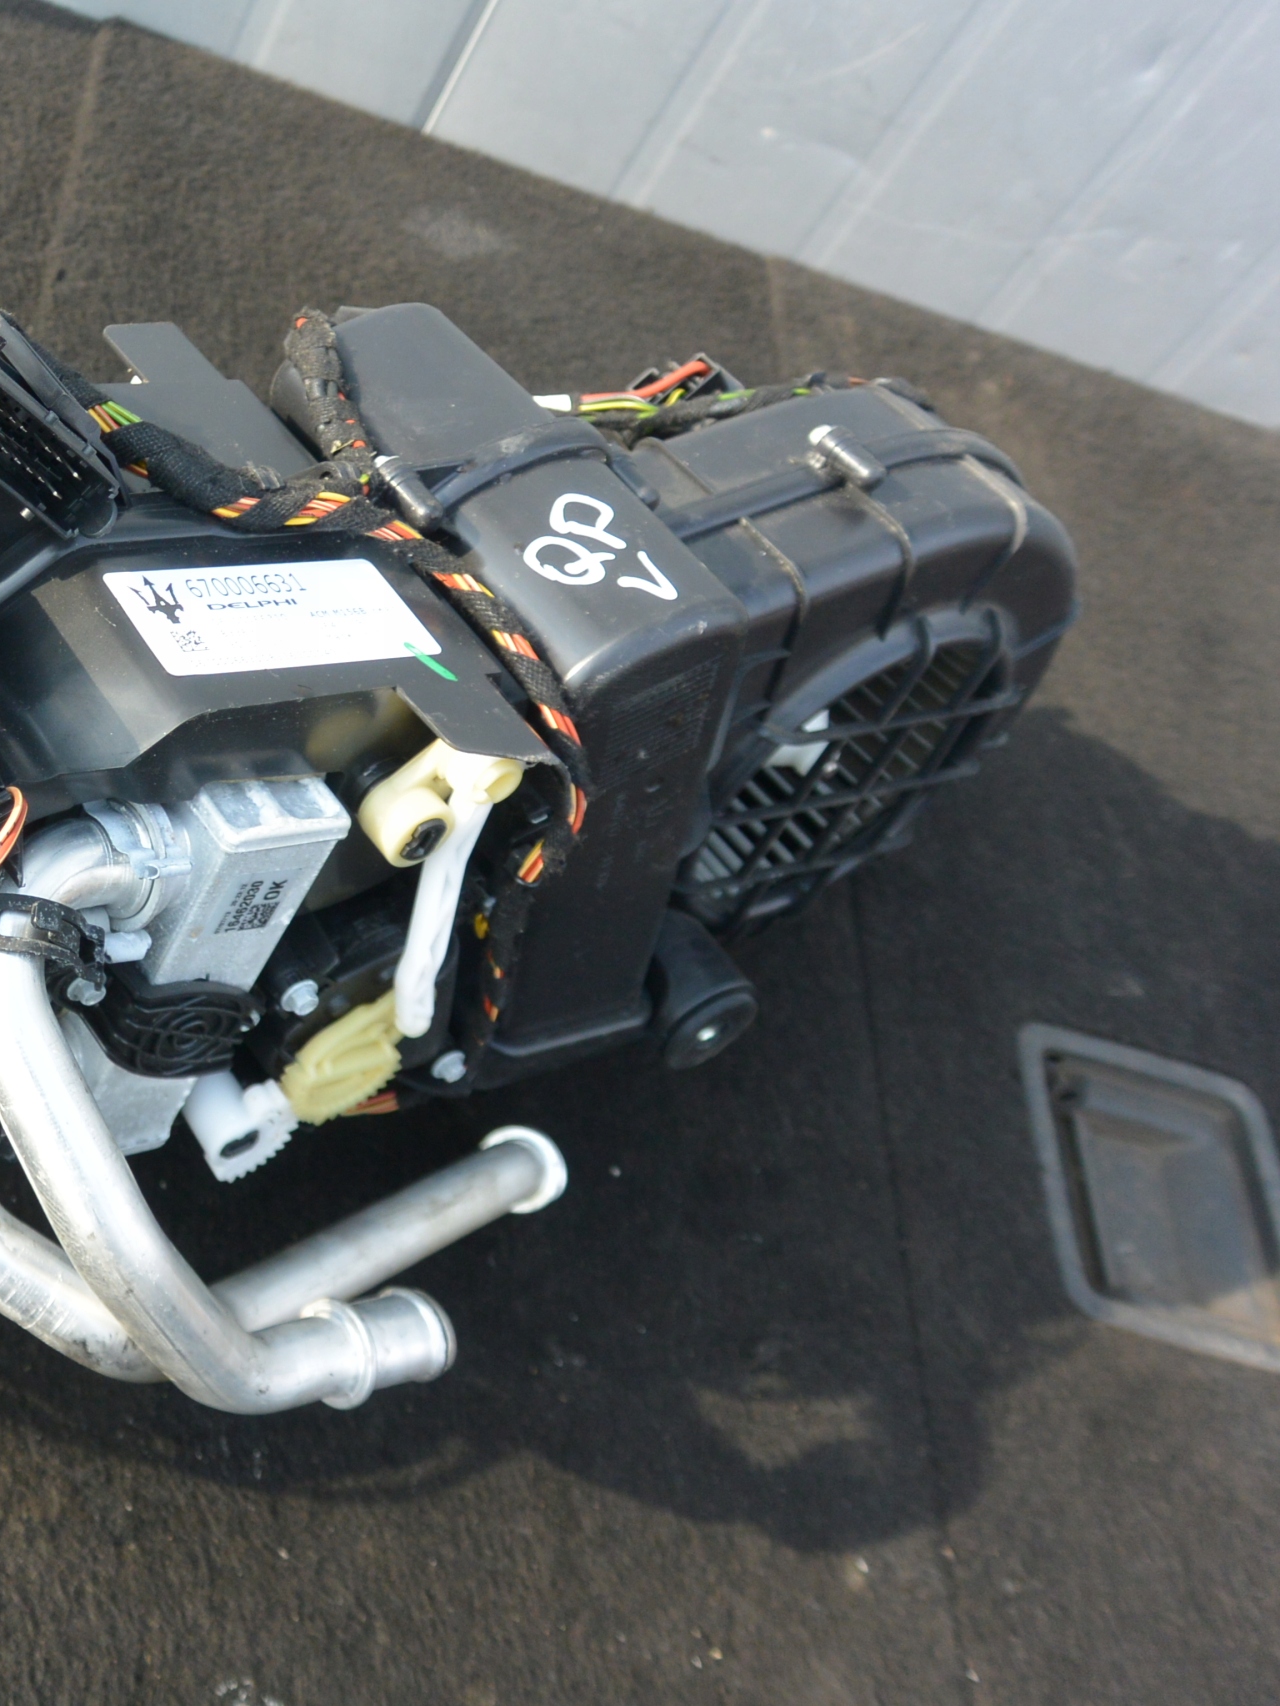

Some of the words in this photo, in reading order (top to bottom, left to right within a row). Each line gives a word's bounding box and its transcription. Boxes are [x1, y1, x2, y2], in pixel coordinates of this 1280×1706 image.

[185, 573, 307, 598] 670006631
[206, 598, 298, 610] DELPHI
[263, 880, 288, 900] OK
[224, 881, 263, 932] 16462030
